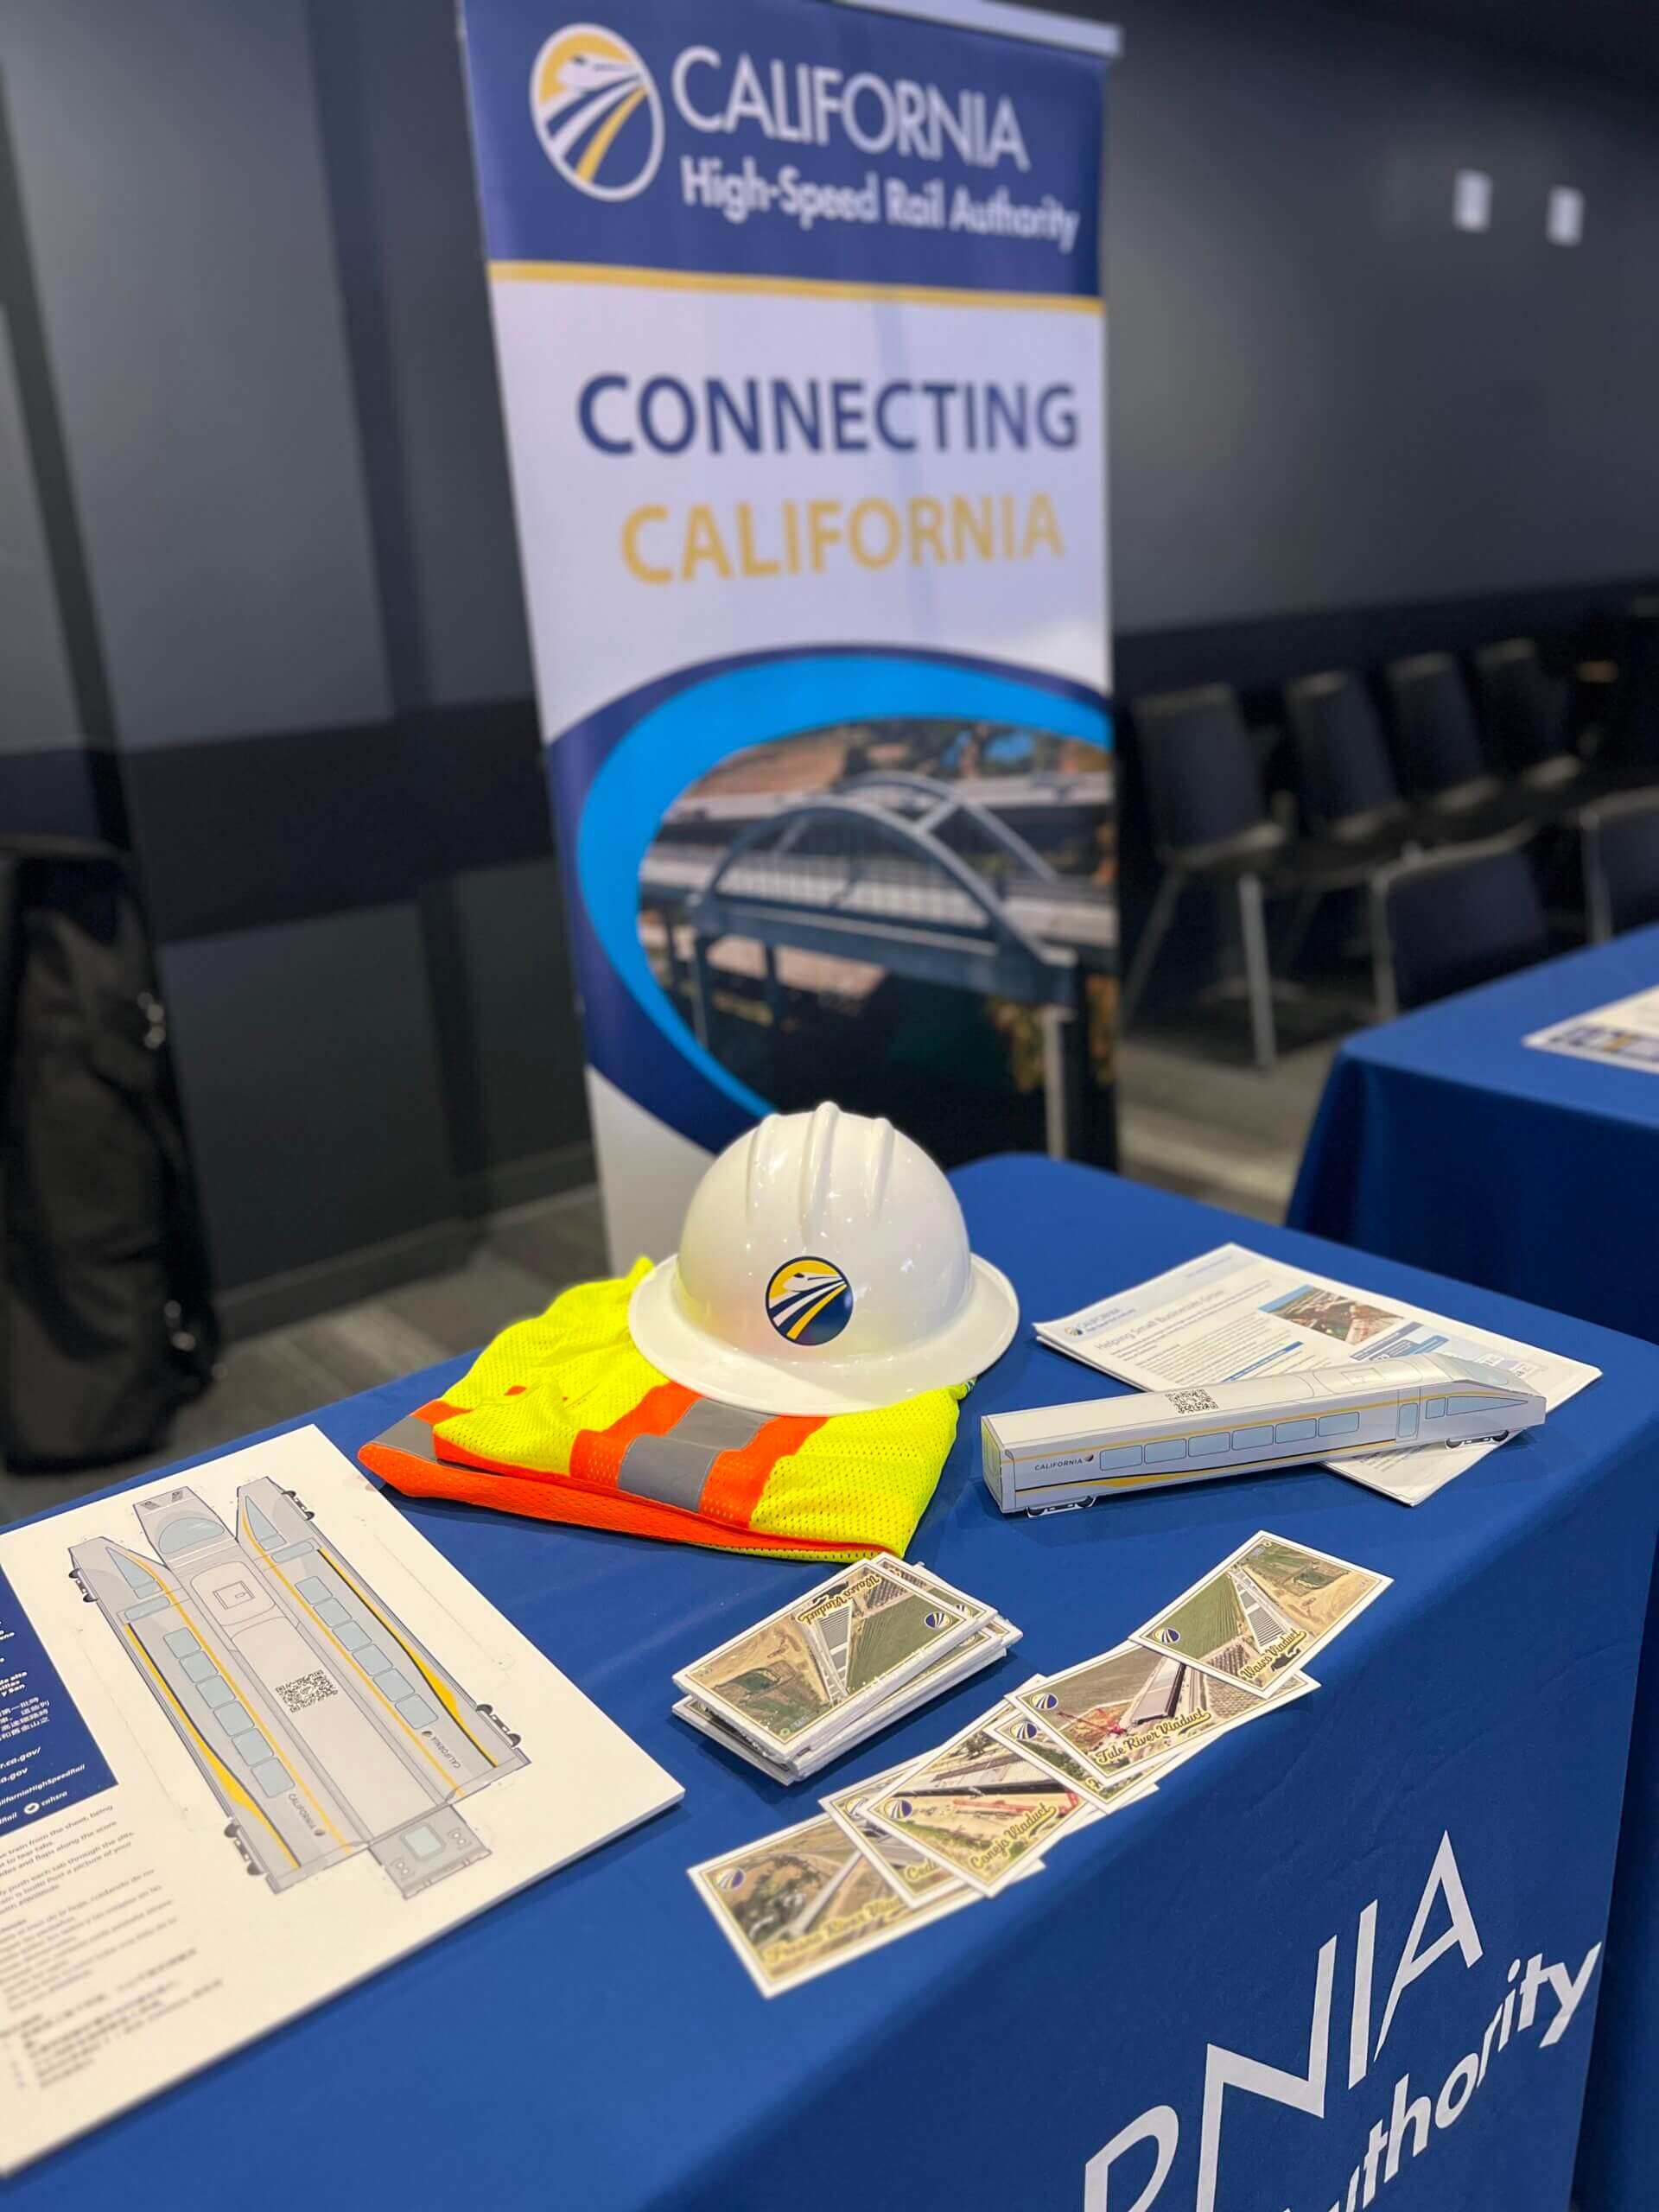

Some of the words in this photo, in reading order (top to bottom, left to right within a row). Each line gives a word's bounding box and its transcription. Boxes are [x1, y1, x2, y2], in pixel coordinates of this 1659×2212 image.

[672, 46, 1031, 172] CALIFORNIA
[680, 155, 879, 229] High-Speed
[886, 180, 944, 228] Rail
[949, 185, 1080, 253] Authority
[576, 373, 1079, 457] CONNECTING
[619, 492, 1065, 585] CALIFORNIA
[1034, 1458, 1083, 1471] CALIFORNIA
[798, 1593, 848, 1625] Viaduct
[844, 1574, 881, 1600] Wasco
[1239, 1653, 1273, 1680] Wasco
[1265, 1628, 1307, 1657] Viaduct
[430, 1735, 462, 1769] CALIFORNIA
[1096, 1747, 1125, 1764] Tule
[1123, 1731, 1160, 1751] River
[1156, 1707, 1211, 1735] Viaduct
[288, 1793, 315, 1830] CALIFORNIA
[969, 1838, 1010, 1869] Conejo
[1002, 1802, 1057, 1840] Viaduct
